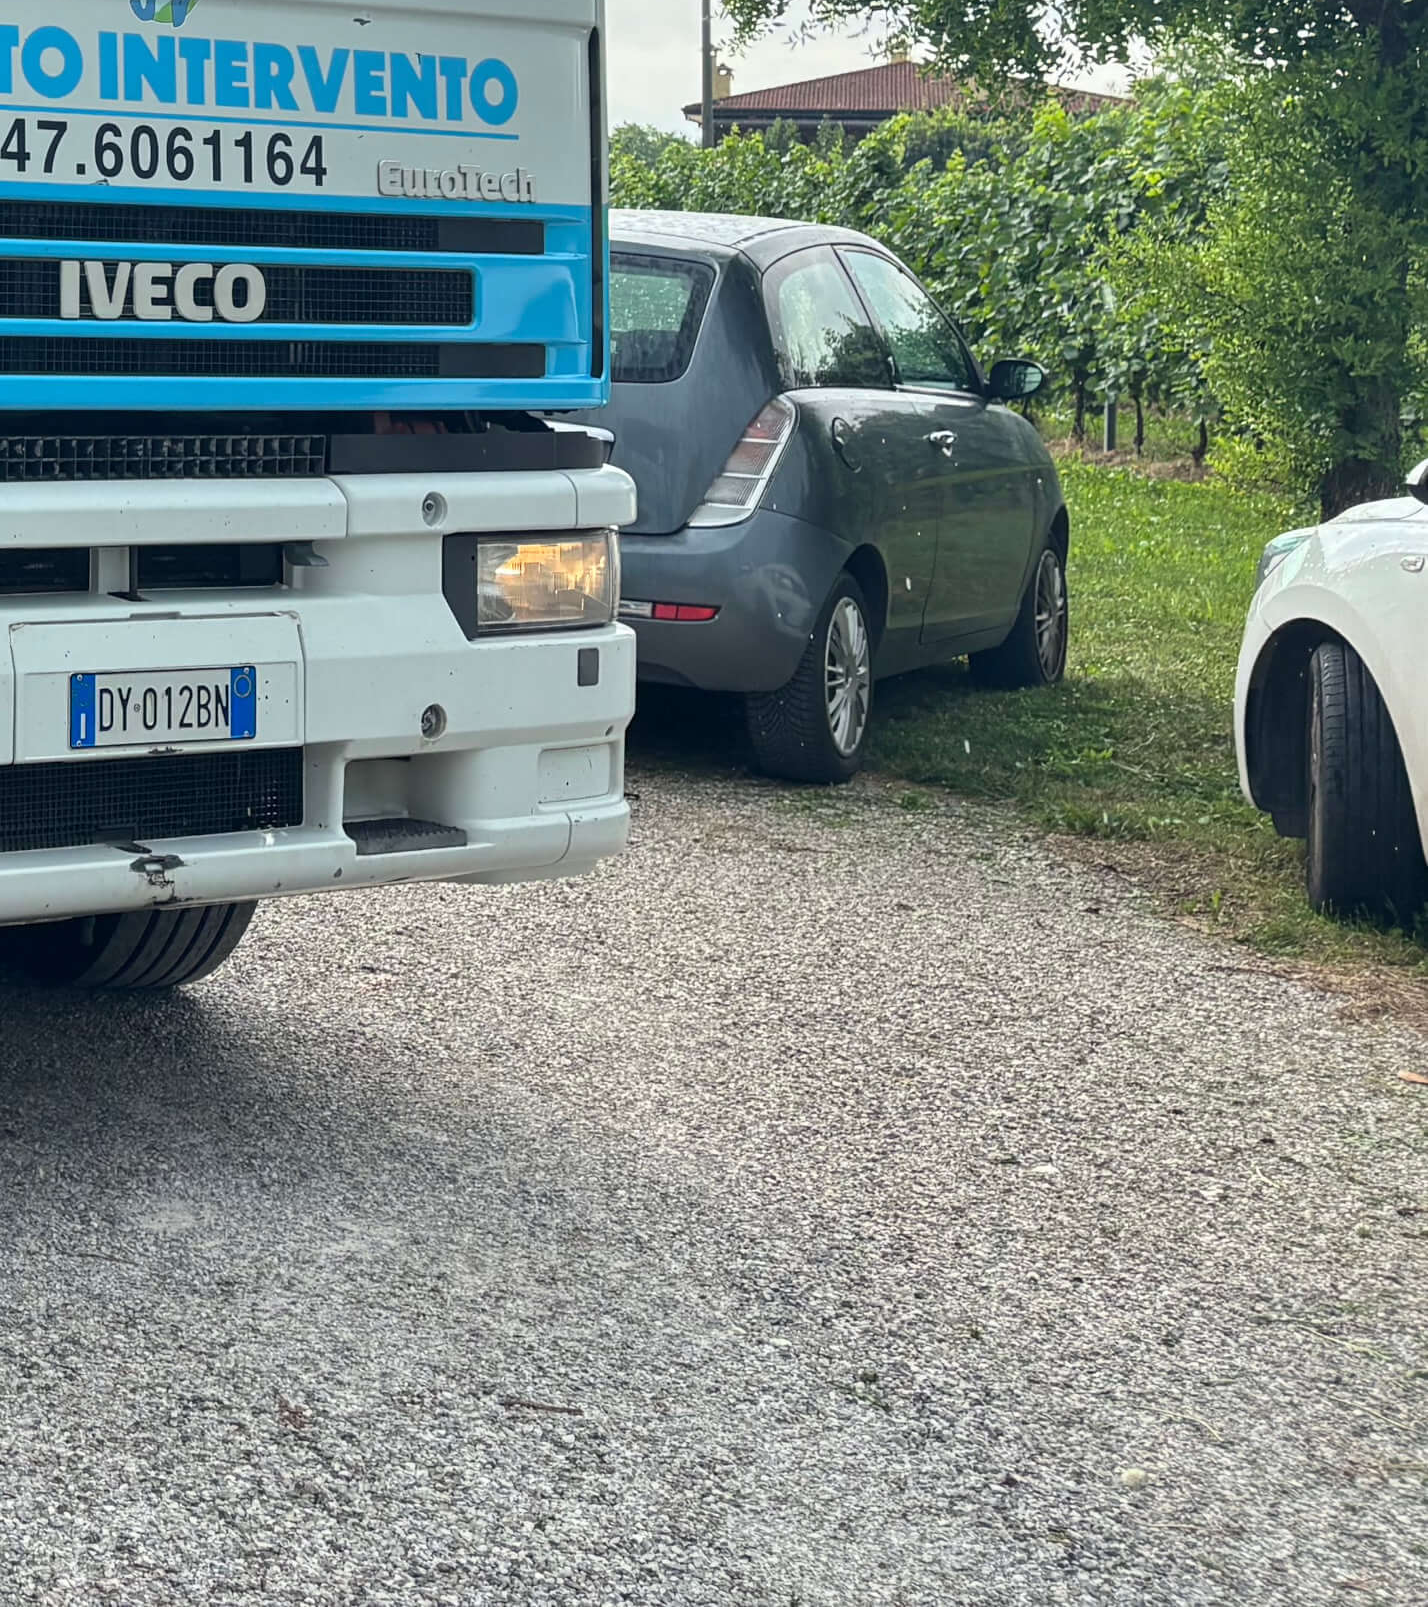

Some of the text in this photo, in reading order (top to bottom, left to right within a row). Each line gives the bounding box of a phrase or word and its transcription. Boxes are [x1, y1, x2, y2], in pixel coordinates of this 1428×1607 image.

[98, 30, 519, 126] INTERVENTO
[377, 159, 537, 204] EuroTech
[59, 260, 267, 323] IVECO
